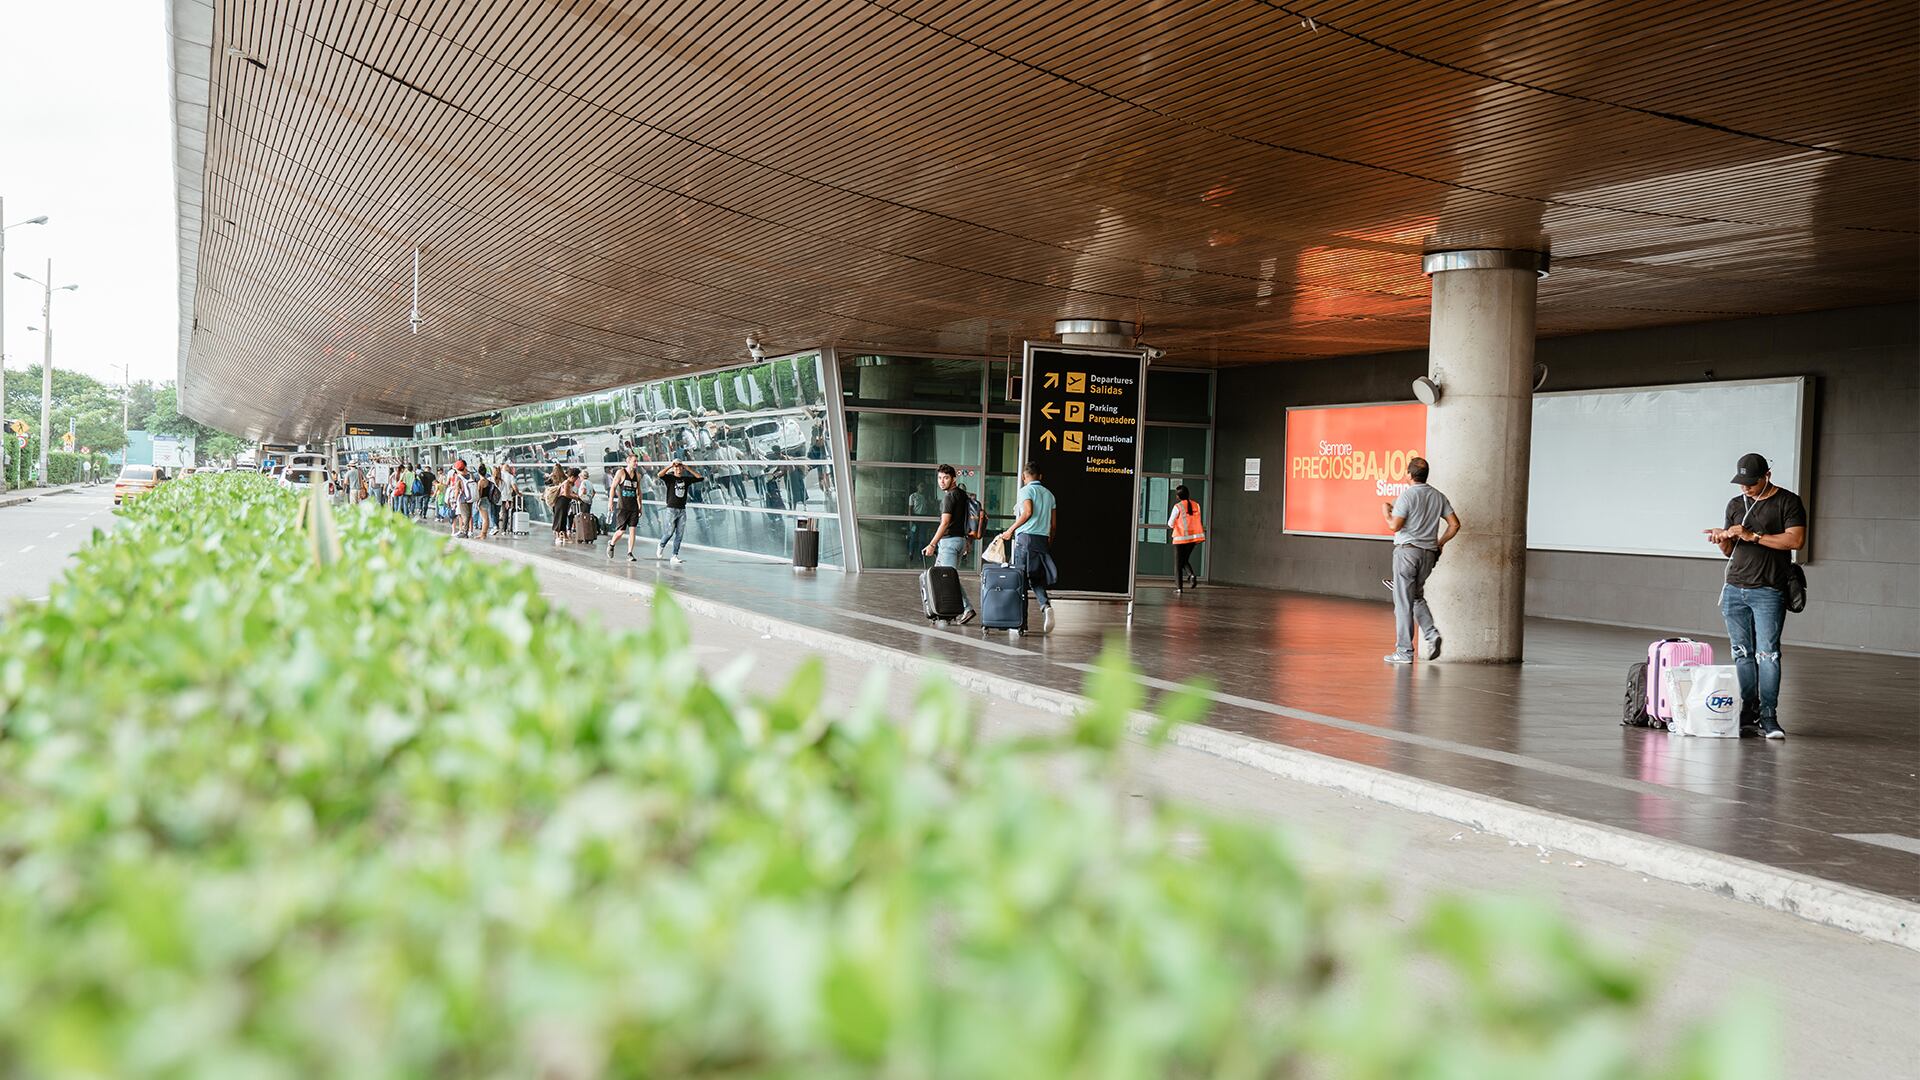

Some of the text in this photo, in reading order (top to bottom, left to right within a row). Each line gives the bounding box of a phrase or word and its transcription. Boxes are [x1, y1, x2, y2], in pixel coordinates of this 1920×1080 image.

[1090, 375, 1134, 385] Departures
[1090, 385, 1123, 395] Salidas
[1070, 405, 1080, 417] P
[1089, 404, 1118, 414] Parking
[1089, 414, 1136, 424] Parqueadero
[1088, 434, 1133, 444] International
[1087, 444, 1114, 452] arrivals
[1319, 440, 1352, 455] Siempre
[1086, 456, 1116, 465] Llegadas
[1711, 696, 1733, 708] DFA
